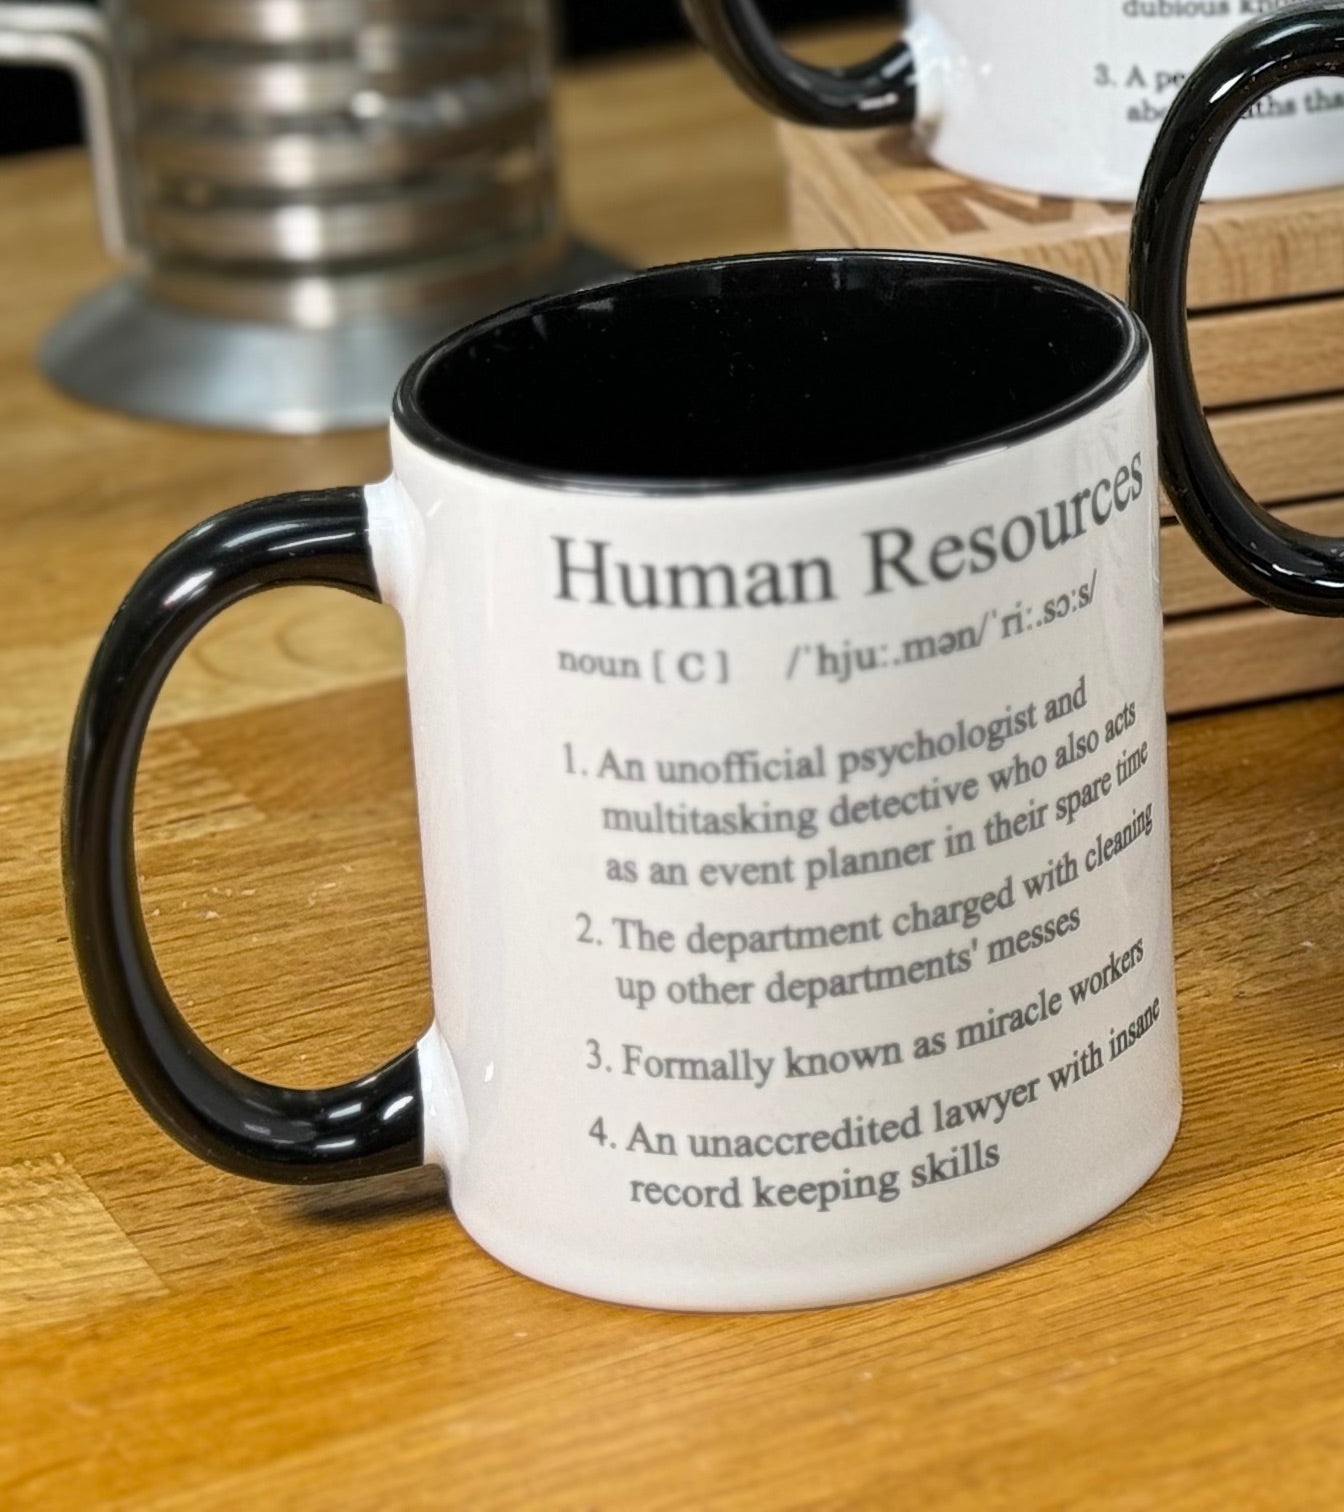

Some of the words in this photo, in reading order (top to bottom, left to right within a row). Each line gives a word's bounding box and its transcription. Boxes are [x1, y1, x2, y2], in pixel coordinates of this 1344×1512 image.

[550, 534, 839, 609] Human
[862, 450, 1144, 596] Resources
[558, 650, 640, 679] noun
[562, 743, 588, 776] 1.
[597, 748, 645, 781] An
[658, 747, 825, 785] unofficial
[838, 702, 1036, 780] psychologist
[1044, 676, 1086, 720] and
[602, 800, 817, 838] multitasking
[829, 774, 980, 828] detective
[988, 753, 1048, 796] who
[1055, 727, 1098, 768] also
[1104, 700, 1136, 742] acts
[576, 912, 602, 944] 2.
[612, 917, 675, 953] The
[686, 918, 882, 961] department
[892, 878, 1014, 937] charged
[1022, 847, 1078, 898] with
[1084, 800, 1153, 873] cleaning
[585, 1038, 612, 1072] 3.
[622, 1045, 774, 1087] Formally
[784, 1042, 902, 1079] known
[912, 1036, 946, 1059] as
[956, 992, 1062, 1049] miracle
[1069, 938, 1144, 1006] workers
[616, 974, 656, 1009] up
[667, 977, 755, 1006] other
[765, 942, 978, 1009] departments'
[986, 907, 1081, 964] messes
